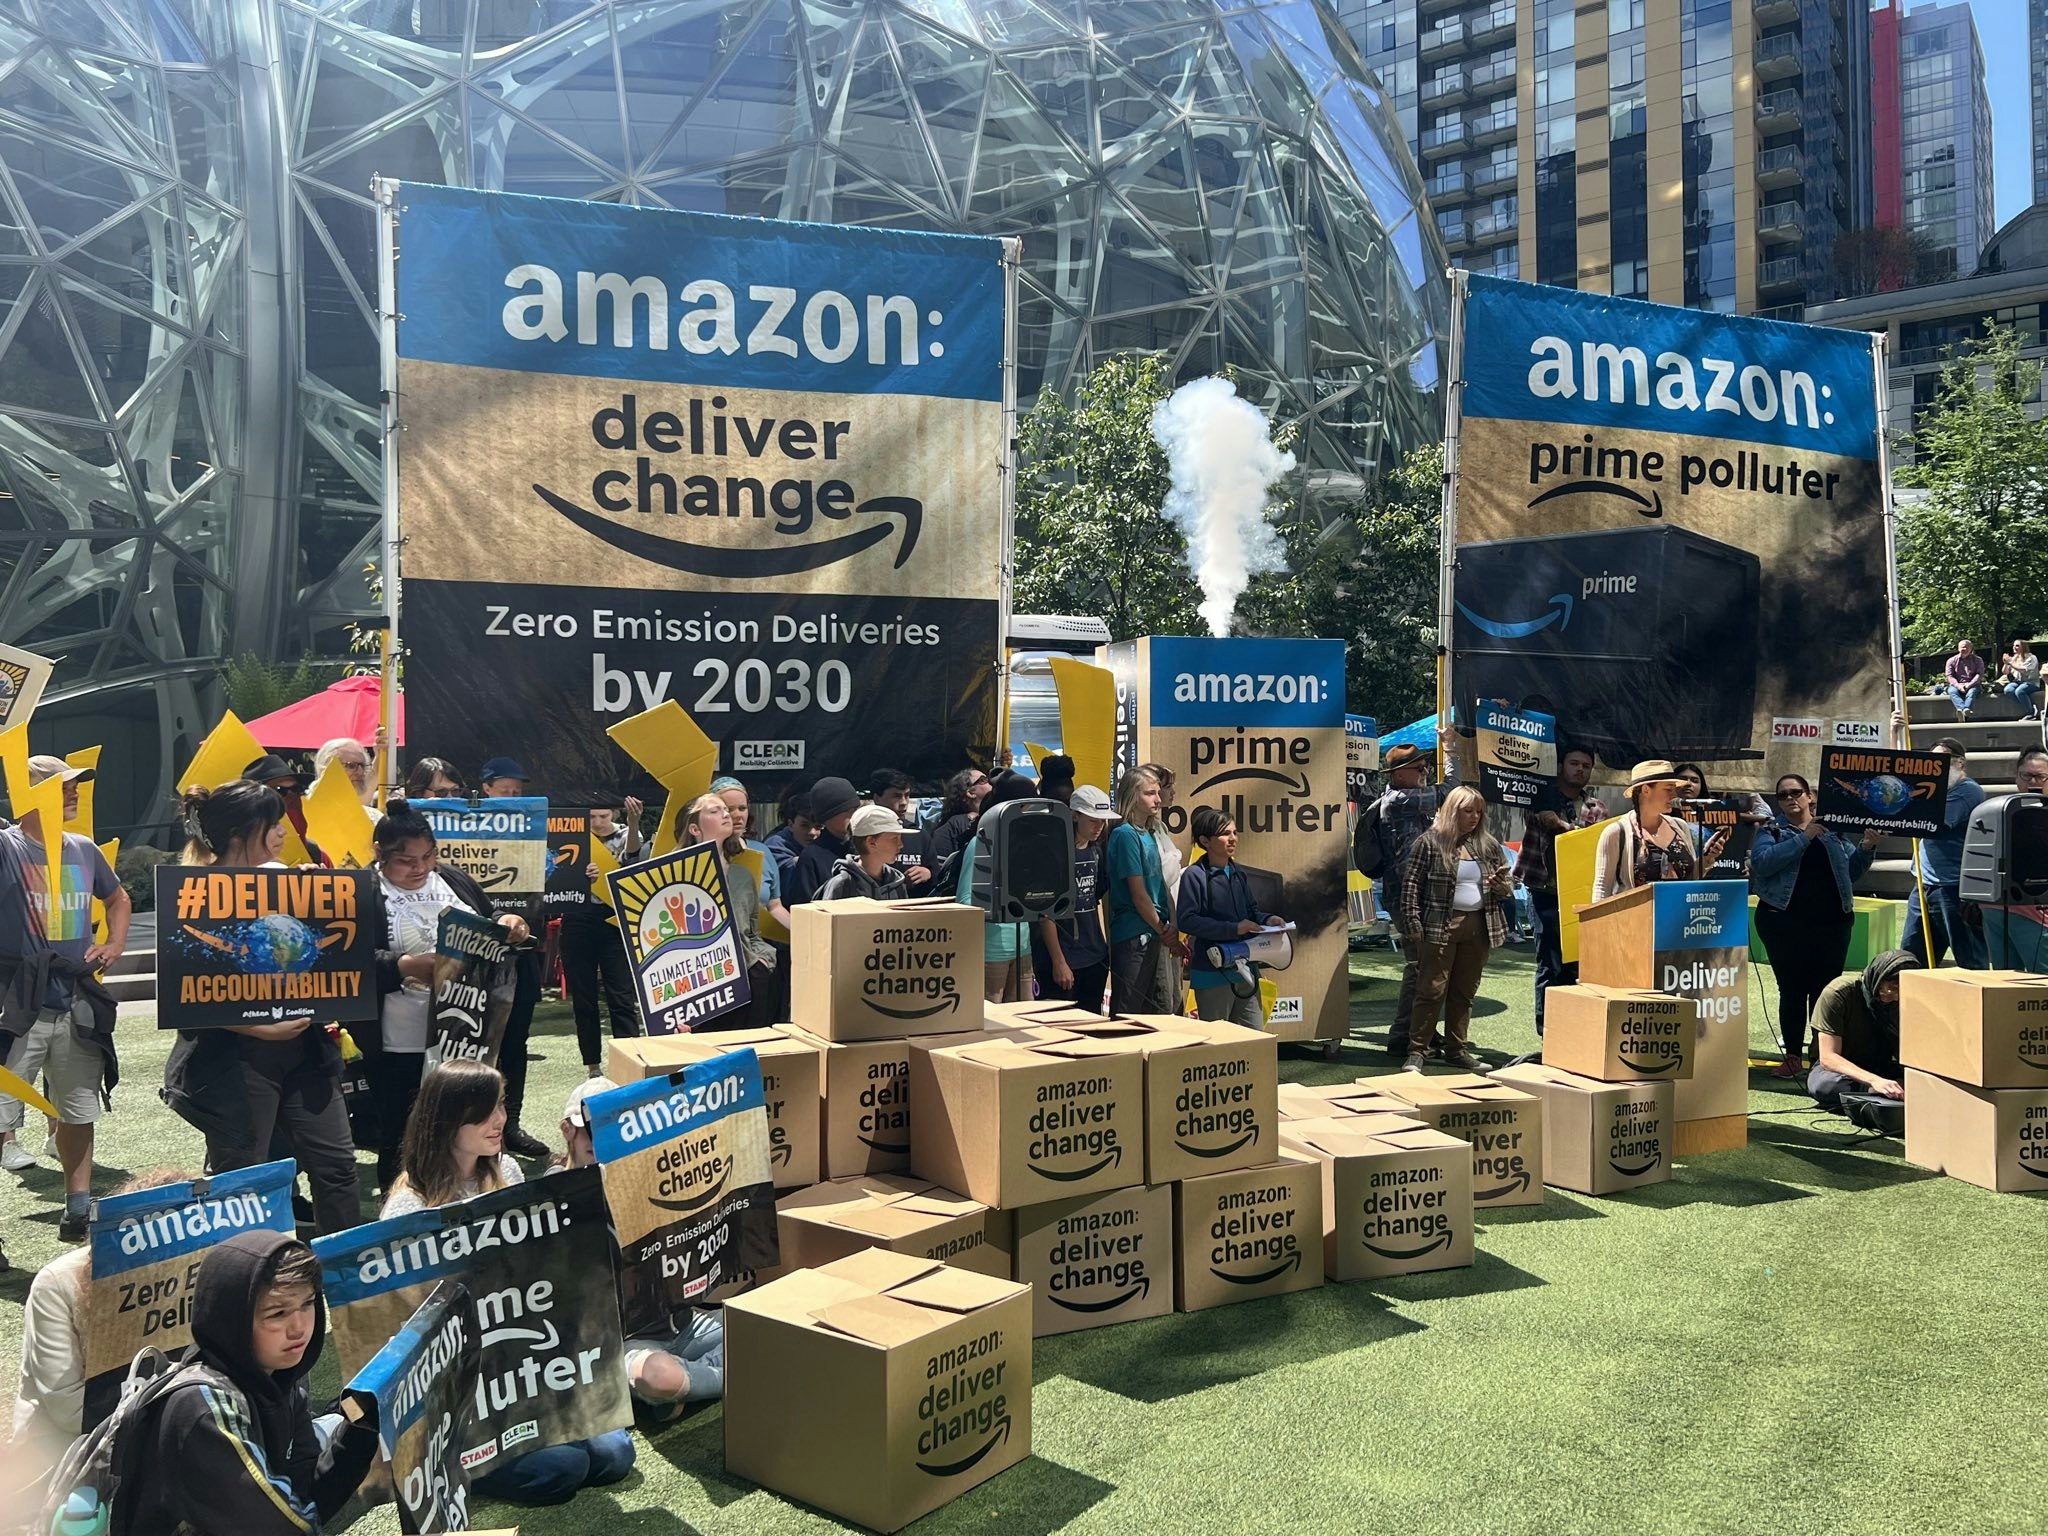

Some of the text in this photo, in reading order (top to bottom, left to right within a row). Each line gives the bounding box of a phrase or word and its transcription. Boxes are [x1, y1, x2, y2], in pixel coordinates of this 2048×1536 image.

[502, 264, 945, 365] amazon:
[1527, 336, 1835, 428] amazon:
[592, 394, 850, 460] deliver
[1530, 434, 1840, 500] prime polluter
[592, 457, 855, 534] change
[1582, 570, 1637, 601] prime
[486, 606, 940, 645] Zero Emission Deliveries
[592, 653, 852, 712] by 2030
[1174, 672, 1327, 704] amazon:
[1116, 681, 1128, 788] Delive
[1488, 712, 1545, 736] amazon:
[1836, 723, 1879, 736] CLEAN
[740, 744, 799, 758] CLEAN
[1190, 726, 1310, 774] prime
[1498, 736, 1530, 750] deliver
[1498, 746, 1530, 761] change
[1347, 772, 1366, 785] 30
[1830, 753, 1942, 777] CLIMATE CHAOS
[1497, 777, 1537, 795] by 2030
[425, 810, 532, 833] amazon:
[546, 817, 585, 832] MAZON
[1161, 795, 1341, 834] plluter
[440, 844, 498, 859] deliver
[177, 873, 357, 919] #DELIVER
[1075, 875, 1094, 888] VANS
[1686, 892, 1721, 903] amazon:
[1690, 905, 1716, 920] prime
[872, 925, 953, 944] amazon:
[1683, 921, 1723, 938] polluter
[650, 944, 731, 988] CLIMATE ACTION
[864, 948, 956, 972] deliver
[180, 971, 361, 1004] ACCOUNTABILITY
[652, 959, 735, 1006] FAMILIES
[864, 972, 956, 999] change
[1664, 962, 1739, 992] Deliver
[663, 986, 735, 1030] SEATTLE
[1627, 1002, 1680, 1014] amazon:
[1621, 1017, 1681, 1036] deliver
[2019, 1027, 2048, 1041] deli
[1619, 1036, 1680, 1058] change
[1181, 1057, 1251, 1084] amazon:
[860, 1079, 908, 1108] deli
[1036, 1076, 1113, 1103] amazon:
[1175, 1082, 1254, 1112] deliver
[618, 1075, 745, 1143] amazon:
[1029, 1102, 1116, 1134] deliver
[1175, 1105, 1255, 1138] change
[1439, 1107, 1518, 1128] amazon:
[1615, 1099, 1658, 1116] amazon:
[1610, 1117, 1659, 1139] deliver
[656, 1133, 718, 1174] deliver
[1029, 1127, 1117, 1161] change
[1610, 1137, 1659, 1159] change
[658, 1155, 722, 1197] change
[1370, 1165, 1444, 1188] amazon:
[1217, 1184, 1292, 1211] amazon:
[1363, 1187, 1448, 1215] deliver
[118, 1192, 272, 1256] amazon:
[1057, 1206, 1140, 1236] amazon:
[1210, 1208, 1295, 1240] deliver
[1363, 1212, 1449, 1240] change
[357, 1201, 571, 1285] amazon:
[641, 1241, 662, 1262] Zero
[666, 1219, 712, 1248] Emission
[661, 1251, 692, 1279] by
[697, 1223, 729, 1264] 2030
[927, 1229, 986, 1260] amazon:
[1049, 1232, 1143, 1265] deliver
[1211, 1234, 1297, 1266] change
[1049, 1259, 1144, 1293] change
[118, 1275, 178, 1314] Zero
[927, 1330, 1003, 1380] amazon:
[918, 1360, 1007, 1421] deliver
[918, 1394, 1007, 1455] change
